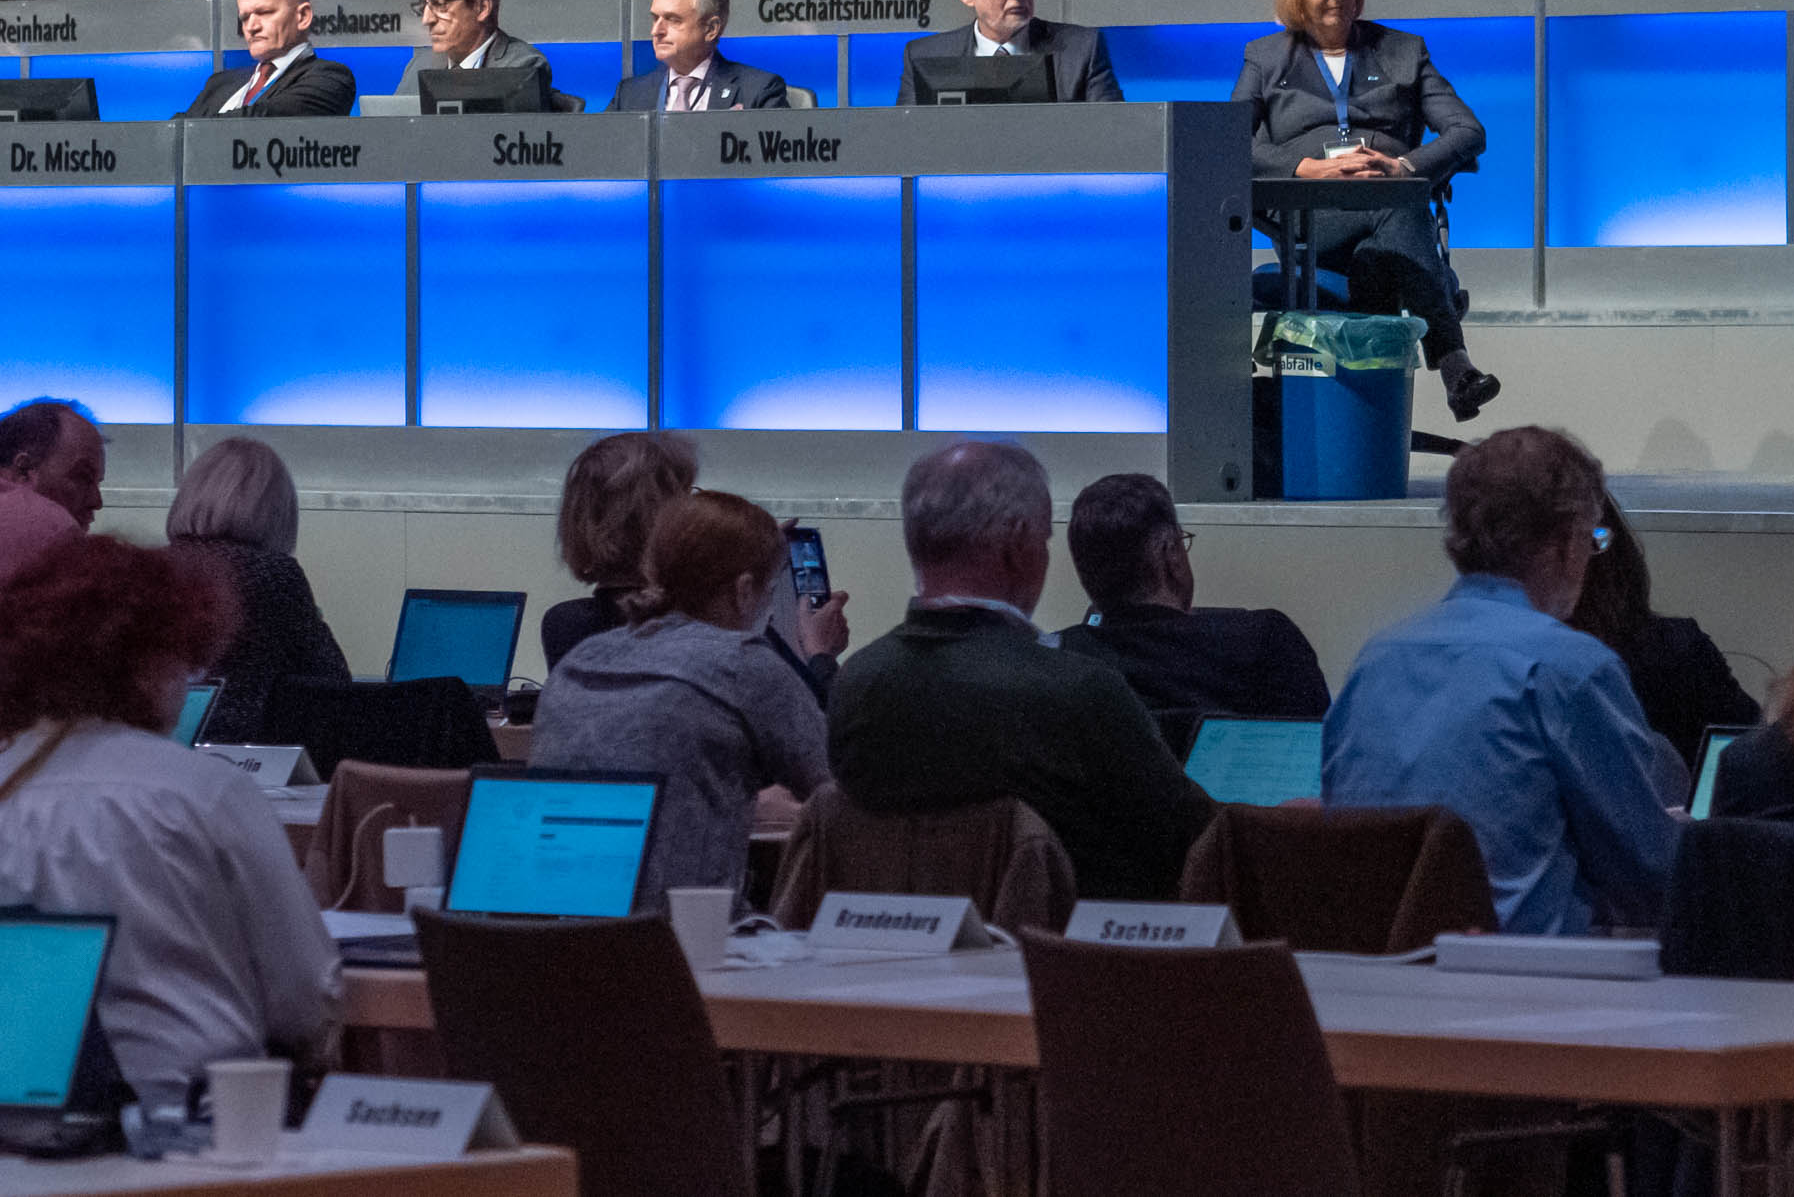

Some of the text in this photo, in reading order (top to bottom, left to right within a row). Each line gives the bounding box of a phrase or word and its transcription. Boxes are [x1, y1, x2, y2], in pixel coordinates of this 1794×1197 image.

[0, 13, 77, 43] Reinhardt
[312, 5, 401, 36] ershausen
[10, 139, 116, 172] Dr. Mischo
[232, 135, 362, 178] Dr. Quitterer
[493, 130, 564, 166] Schulz
[720, 126, 841, 164] Dr. Wenker
[237, 757, 262, 773] rlin
[835, 908, 941, 934] Brandenburg
[1100, 919, 1187, 941] Sachsen
[345, 1098, 443, 1128] Sachsen
